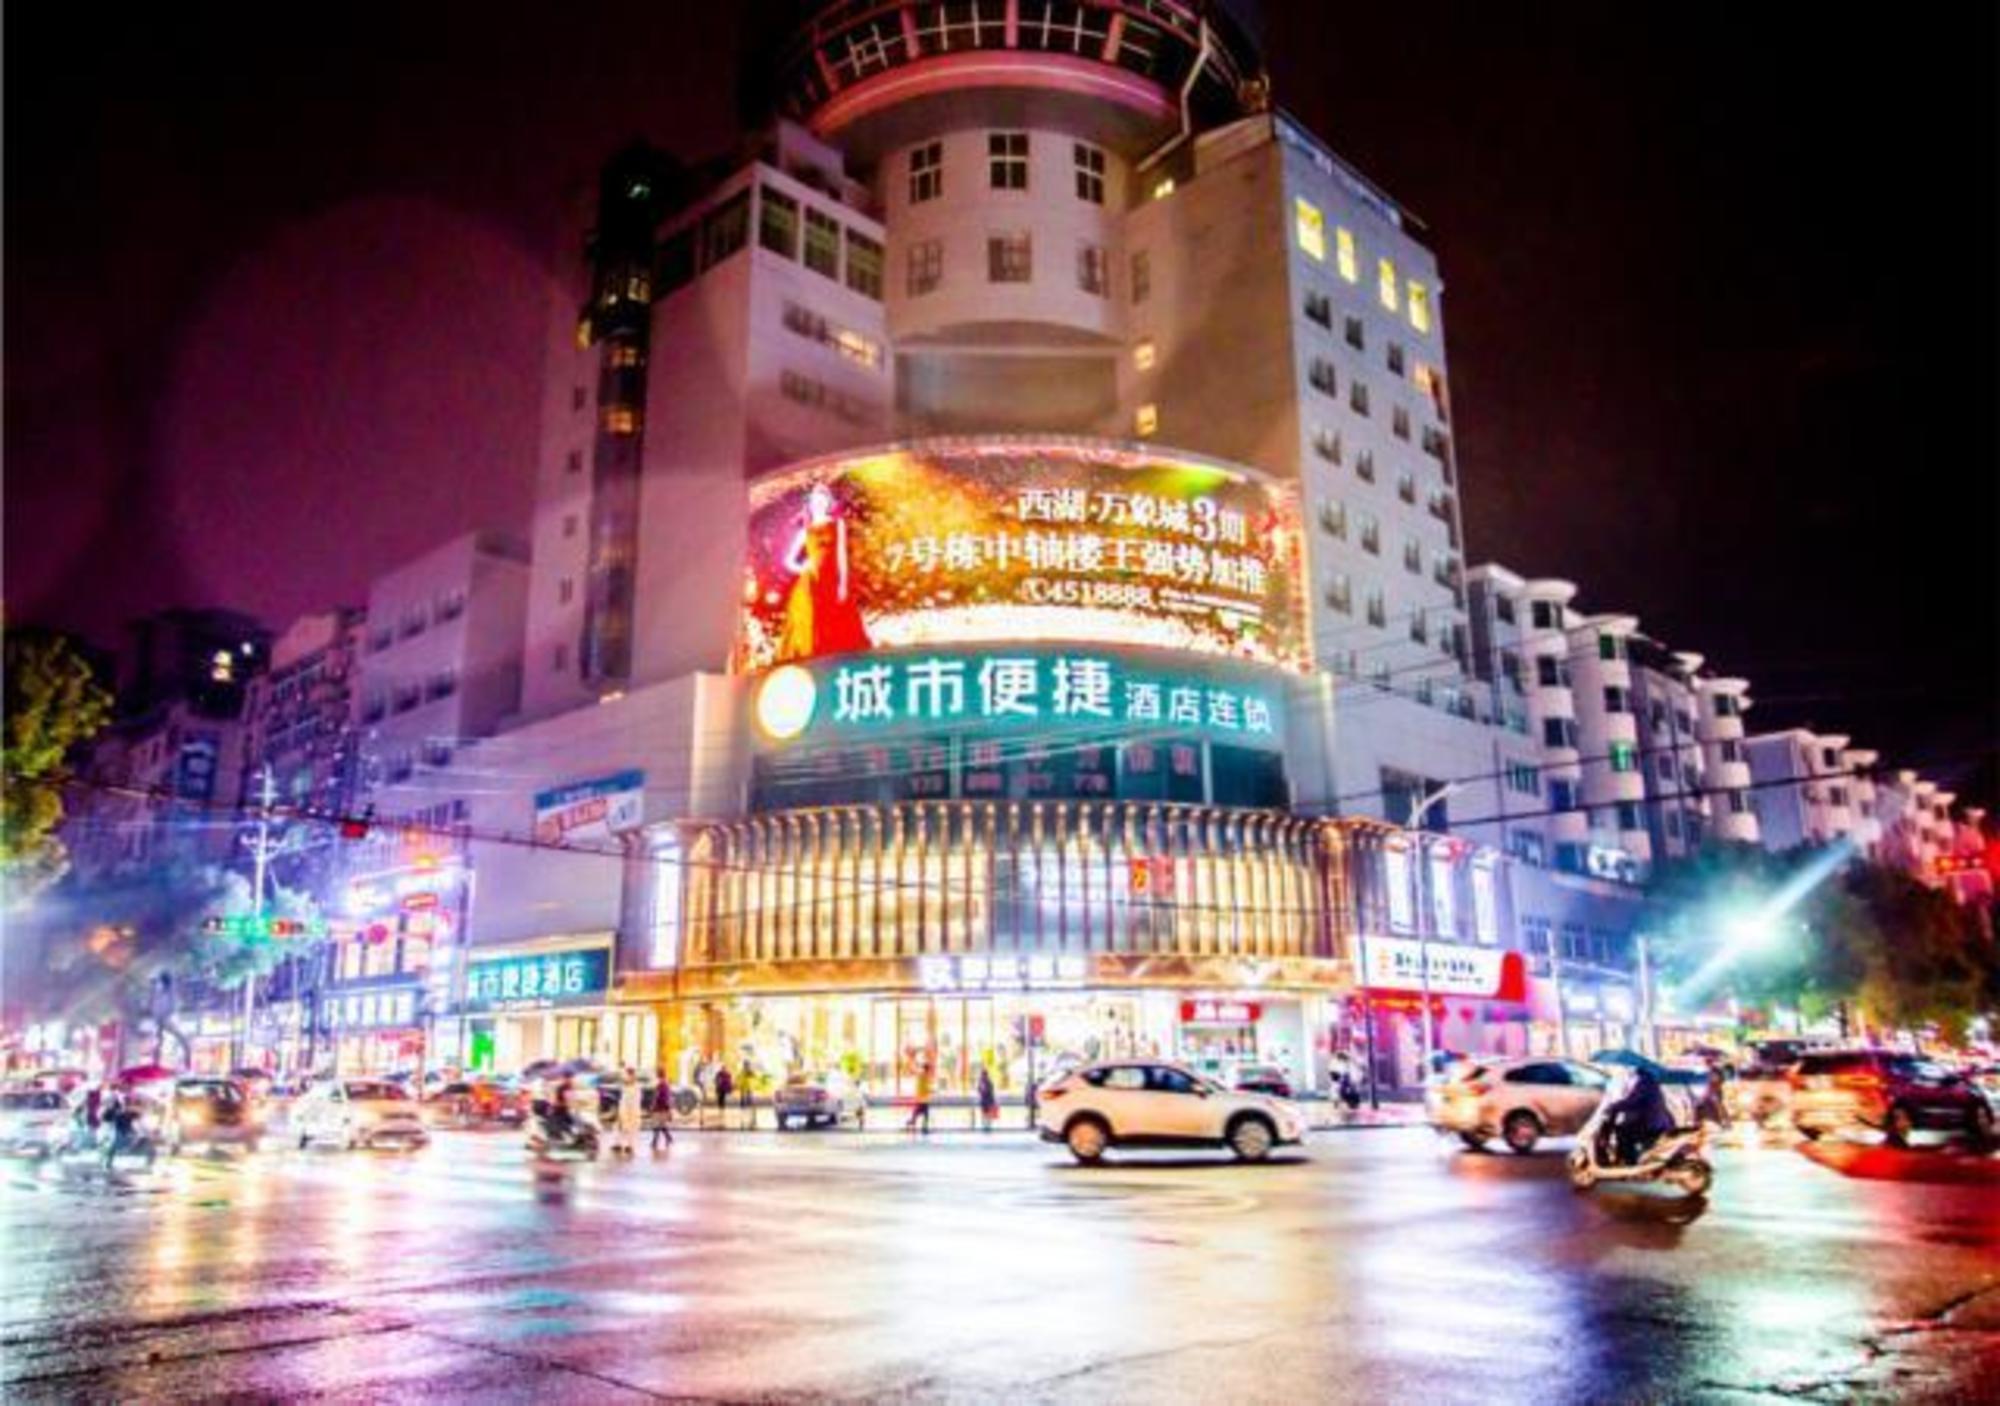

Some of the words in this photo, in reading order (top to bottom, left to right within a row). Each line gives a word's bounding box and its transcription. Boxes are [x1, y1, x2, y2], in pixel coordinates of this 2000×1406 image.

[833, 657, 1111, 721] 城市便捷
[1125, 680, 1273, 733] 酒店连锁
